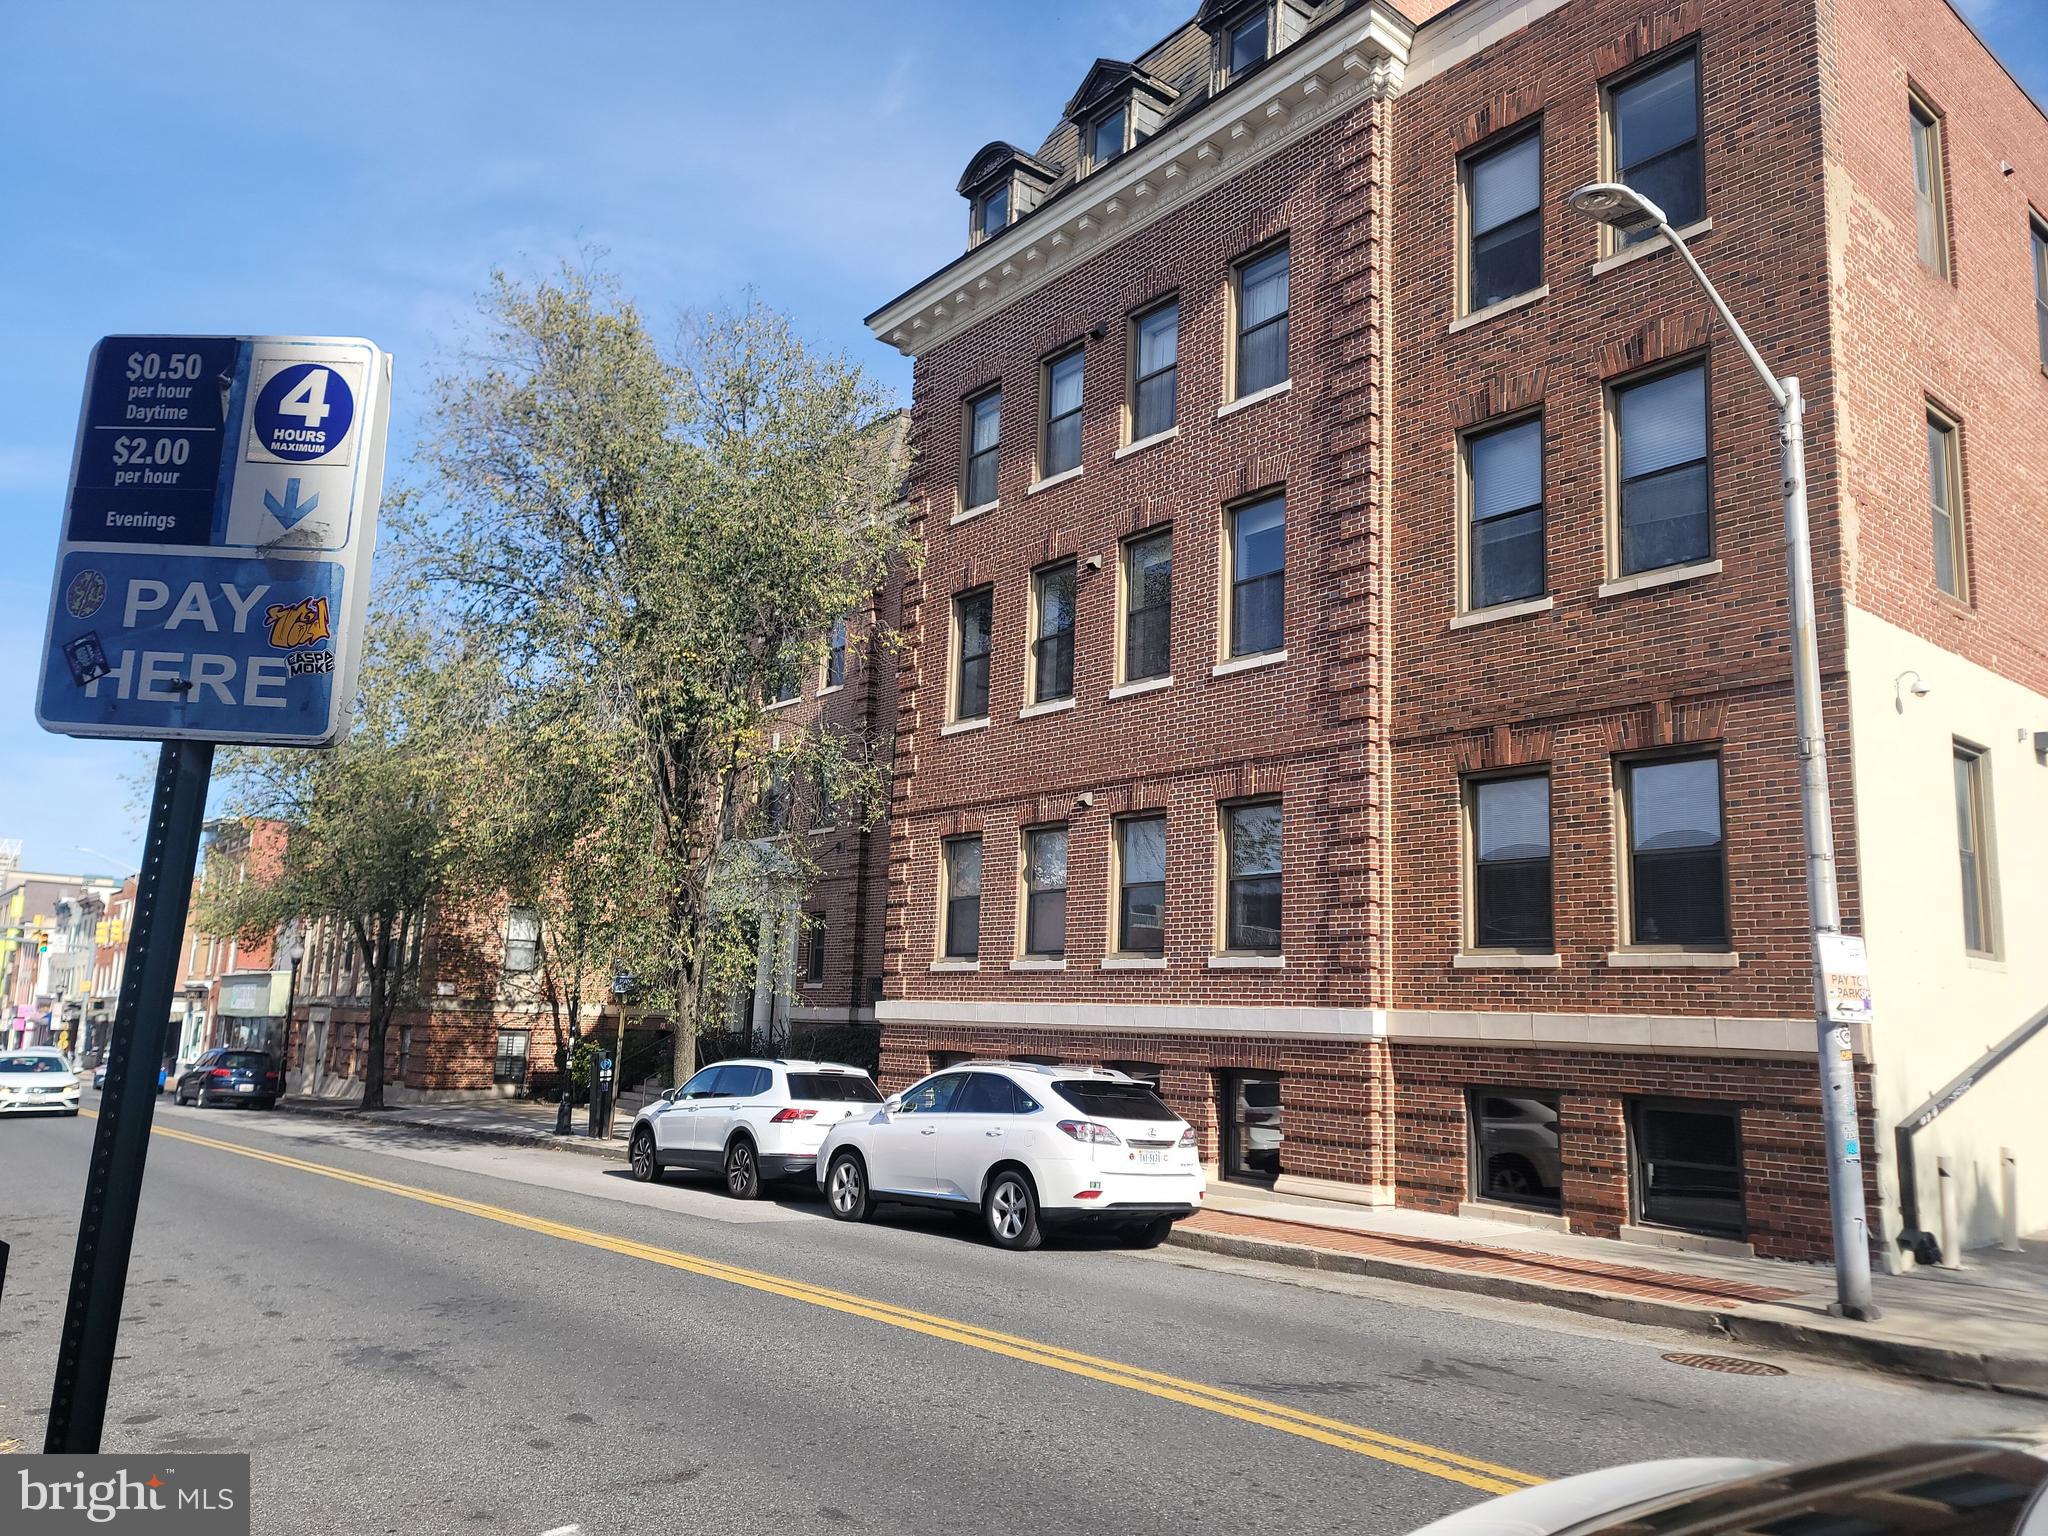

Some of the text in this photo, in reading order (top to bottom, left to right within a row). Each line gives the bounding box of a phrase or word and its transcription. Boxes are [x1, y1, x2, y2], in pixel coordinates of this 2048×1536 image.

[126, 352, 202, 381] $0.50
[128, 383, 192, 401] per hour
[279, 368, 330, 428] 4
[126, 404, 189, 423] Daytime
[273, 428, 326, 443] HOURS
[112, 435, 190, 466] $2.00
[270, 442, 325, 453] MAXIMUM
[114, 468, 180, 486] per hour
[106, 511, 176, 531] Evenings
[122, 579, 272, 633] PAY
[84, 649, 288, 708] HERE
[1831, 974, 1849, 986] PAY
[1837, 987, 1861, 1000] PARK
